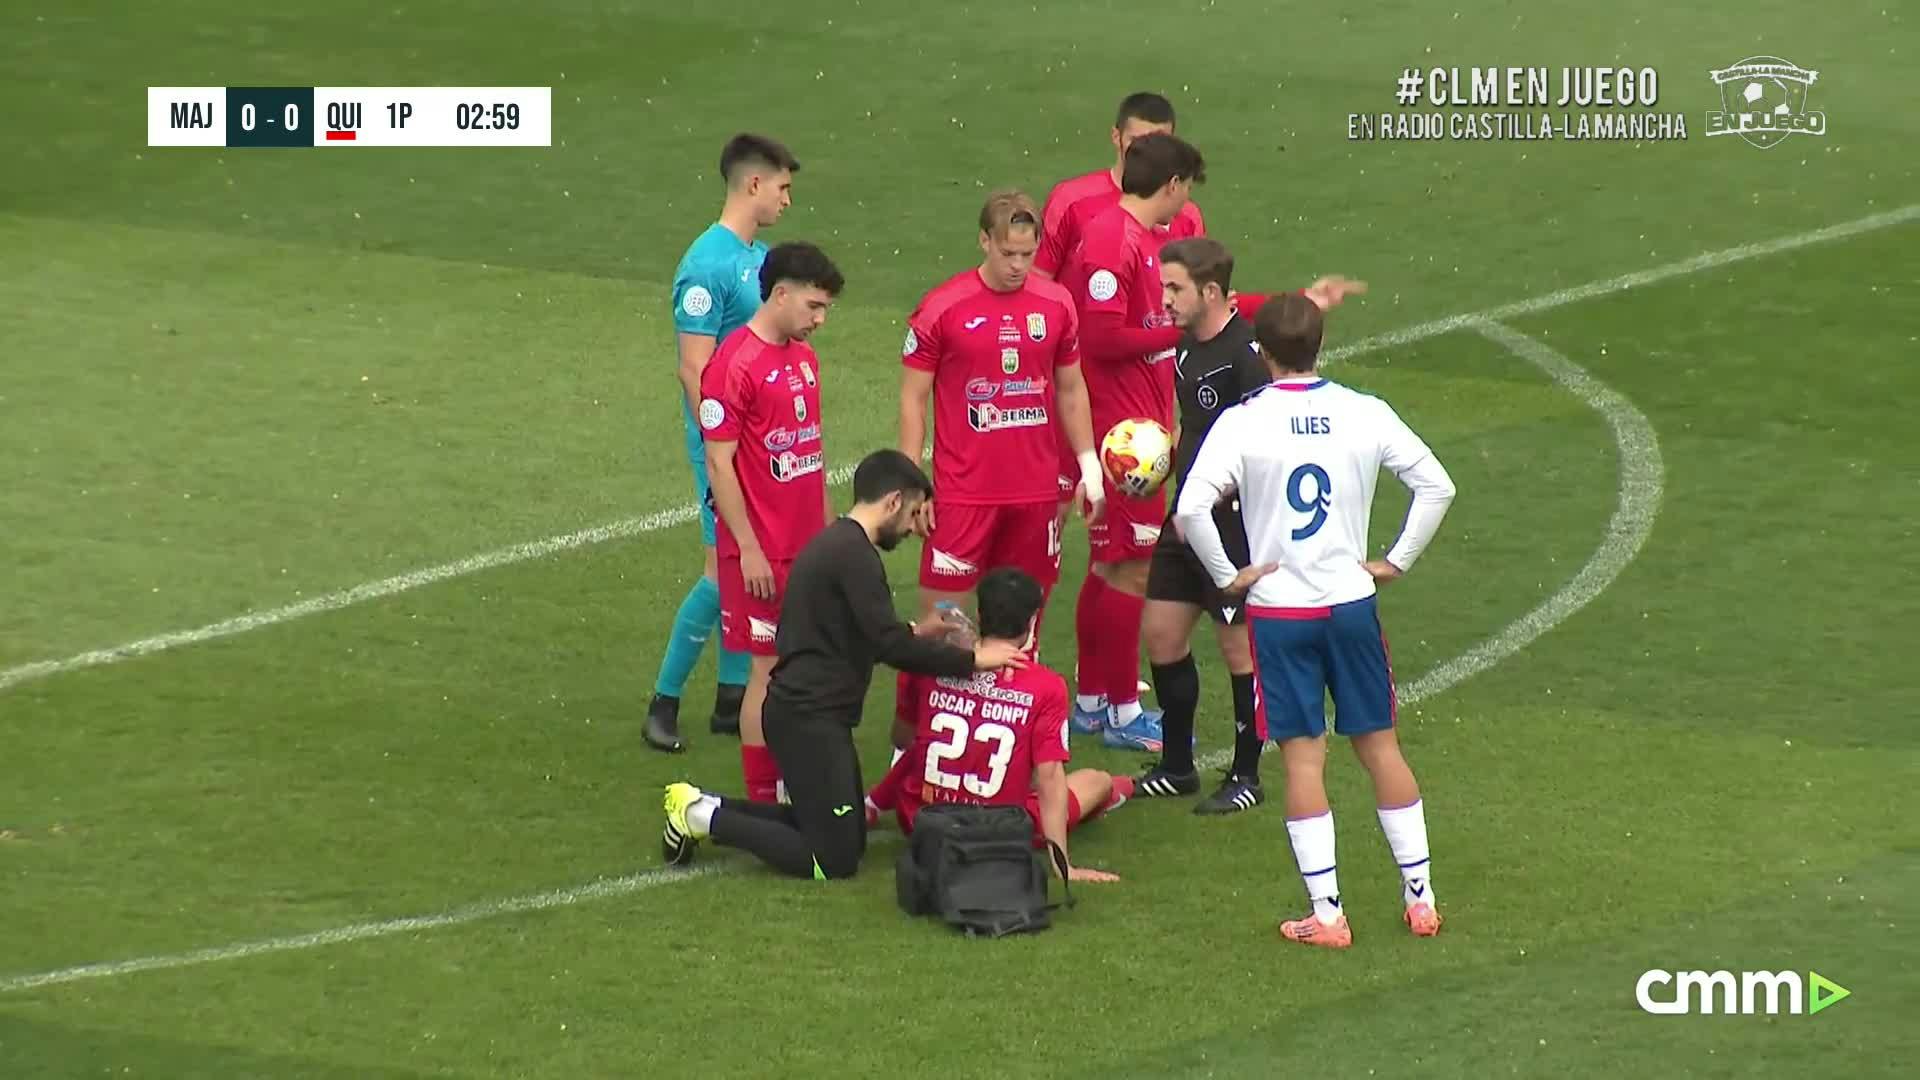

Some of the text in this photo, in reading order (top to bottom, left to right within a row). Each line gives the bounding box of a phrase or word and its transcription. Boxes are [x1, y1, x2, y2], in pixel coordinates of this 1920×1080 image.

[1290, 416, 1331, 435] ILIES
[1286, 462, 1332, 542] 9
[928, 690, 1030, 726] OSCAR GONPI
[924, 712, 1016, 799] 23
